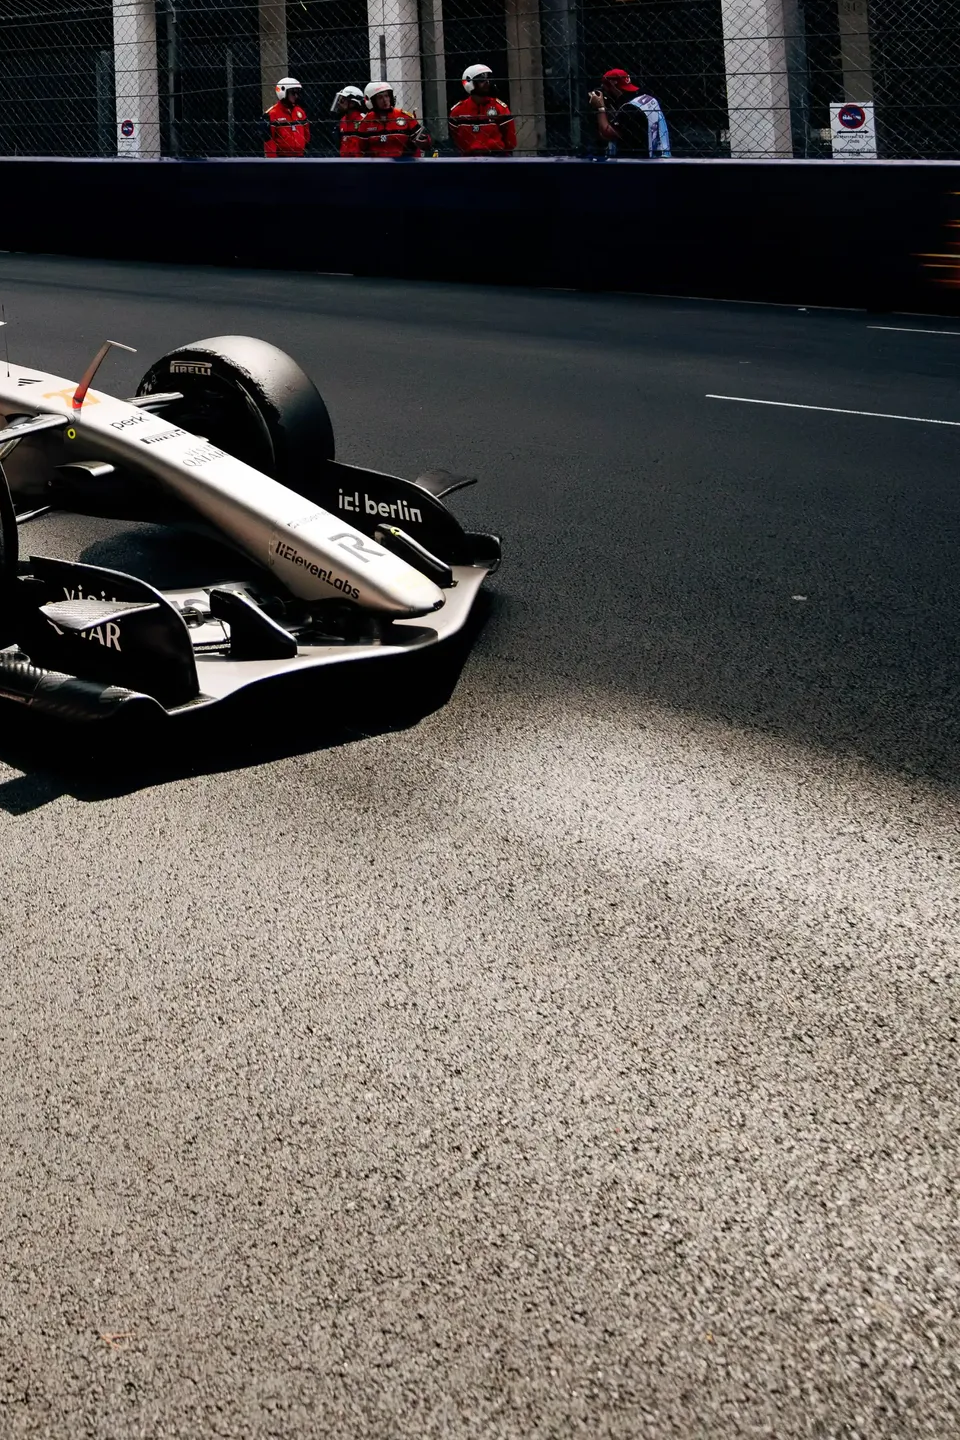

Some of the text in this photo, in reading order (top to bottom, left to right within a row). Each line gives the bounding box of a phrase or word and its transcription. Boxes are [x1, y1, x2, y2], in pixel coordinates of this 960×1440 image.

[169, 360, 213, 376] PIRELLI
[139, 428, 187, 445] PIRELLI
[364, 493, 423, 523] berlin
